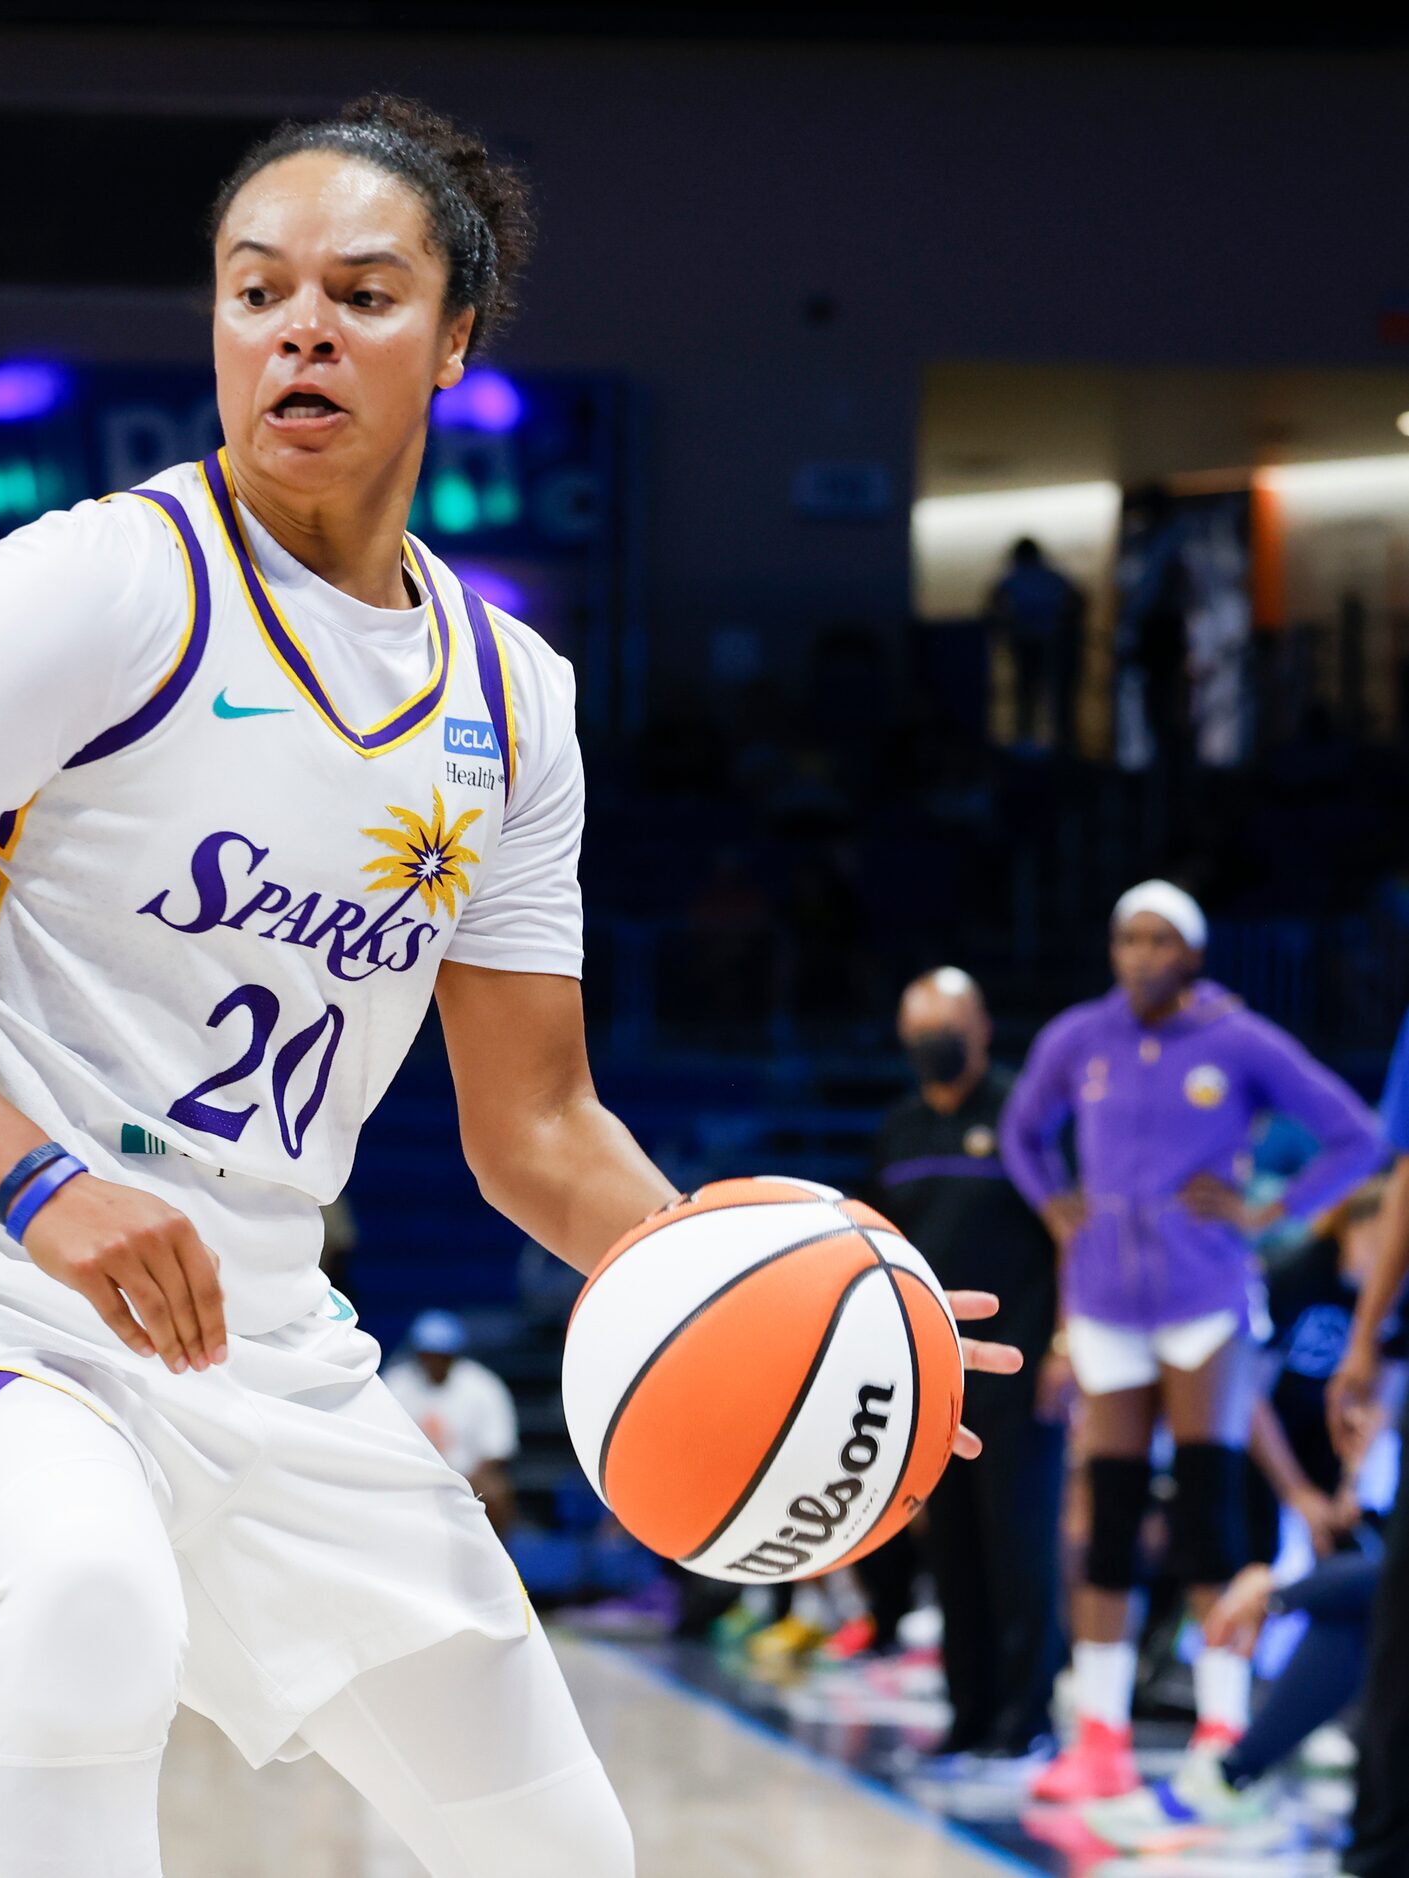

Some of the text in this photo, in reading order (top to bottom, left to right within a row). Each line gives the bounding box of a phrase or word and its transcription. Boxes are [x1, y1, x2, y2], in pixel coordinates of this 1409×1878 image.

[449, 727, 494, 750] UCLA
[167, 984, 344, 1159] 20
[724, 1381, 895, 1576] Wilson
